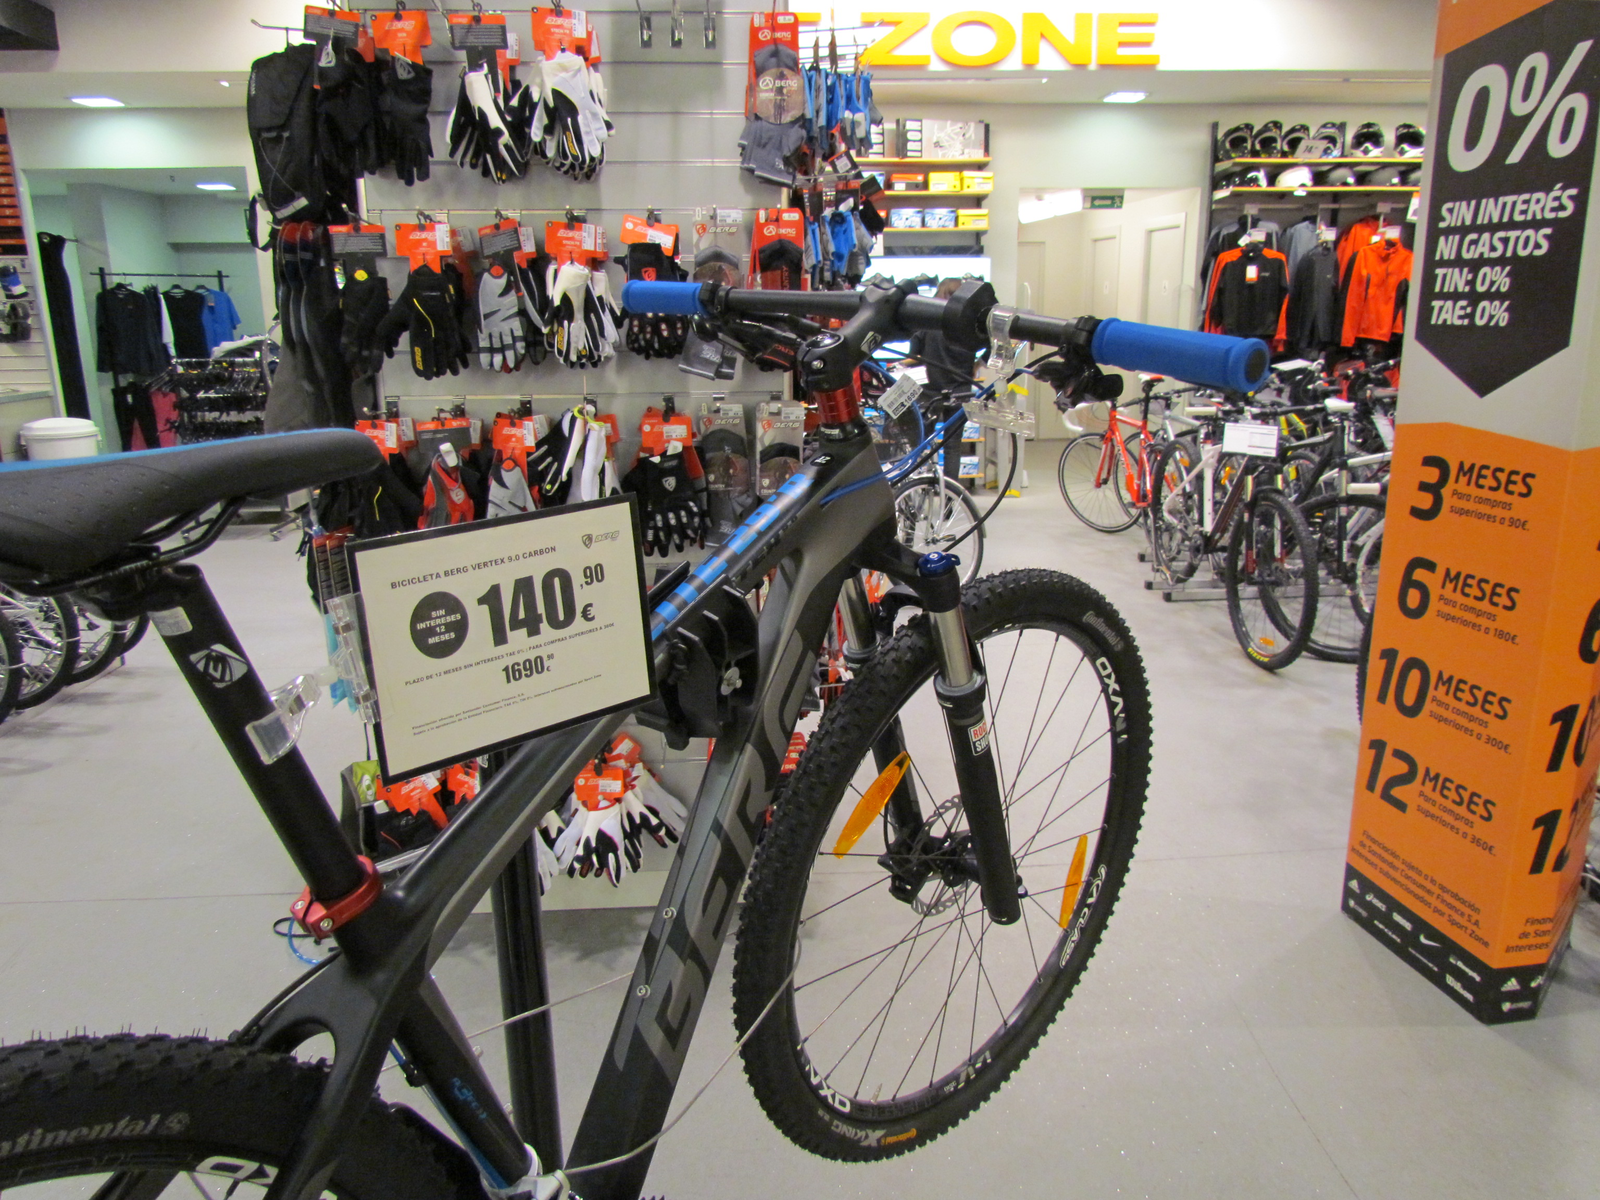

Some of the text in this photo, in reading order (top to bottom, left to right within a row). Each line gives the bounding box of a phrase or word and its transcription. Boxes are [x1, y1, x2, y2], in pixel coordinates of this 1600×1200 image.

[858, 10, 1160, 67] ZONE
[1447, 39, 1594, 172] 0%
[1438, 183, 1579, 228] SIN INTERÉS
[1435, 228, 1553, 260] NI GASTOS
[1434, 265, 1512, 292] TIN: 0%
[1430, 300, 1511, 326] TAE: 0%
[714, 418, 741, 426] BERG
[773, 421, 801, 429] BERG
[1409, 455, 1451, 521] 3
[1454, 460, 1536, 498] MESES
[1449, 504, 1530, 532] superiores a 90€.
[1452, 489, 1513, 511] Para compras
[594, 531, 620, 543] BERG
[390, 546, 556, 590] BICICLETA BERG VERTEX 9.0 CARBON
[1397, 556, 1438, 620] 6
[1441, 567, 1520, 611] MESES
[416, 613, 462, 630] INTERESES
[431, 609, 446, 618] SIN
[476, 567, 577, 648] 140
[581, 603, 596, 622] €
[1438, 594, 1498, 622] Para compras
[428, 632, 456, 645] MESES
[435, 625, 446, 633] 12
[1436, 608, 1520, 646] superiores a 180€.
[404, 677, 425, 687] PLAZO
[443, 666, 463, 675] MESES
[475, 654, 505, 667] INTERESES
[528, 643, 543, 651] PARA
[543, 636, 568, 647] COMPRAS
[568, 627, 599, 640] SUPERIORES
[502, 655, 545, 685] 1690
[1376, 646, 1431, 719] 10
[1433, 669, 1512, 721] MESES
[1429, 709, 1474, 737] superiores
[1476, 731, 1482, 740] a
[1430, 695, 1489, 729] Para compras
[1365, 738, 1418, 814] 12
[1421, 766, 1496, 822] MESES
[1416, 804, 1460, 835] superiores
[1462, 831, 1467, 840] a
[1418, 790, 1475, 829] Para compras
[1359, 840, 1367, 849] de
[1367, 845, 1400, 873] Santander
[1400, 869, 1435, 897] Consumer
[1436, 893, 1466, 918] Finance
[1362, 830, 1401, 861] Financiación
[1402, 858, 1423, 878] sujeto
[1430, 876, 1437, 887] la
[1438, 883, 1481, 915] aprobación
[1350, 845, 1490, 949] Intereses subvencionados por Sport Zone
[1518, 930, 1531, 940] de
